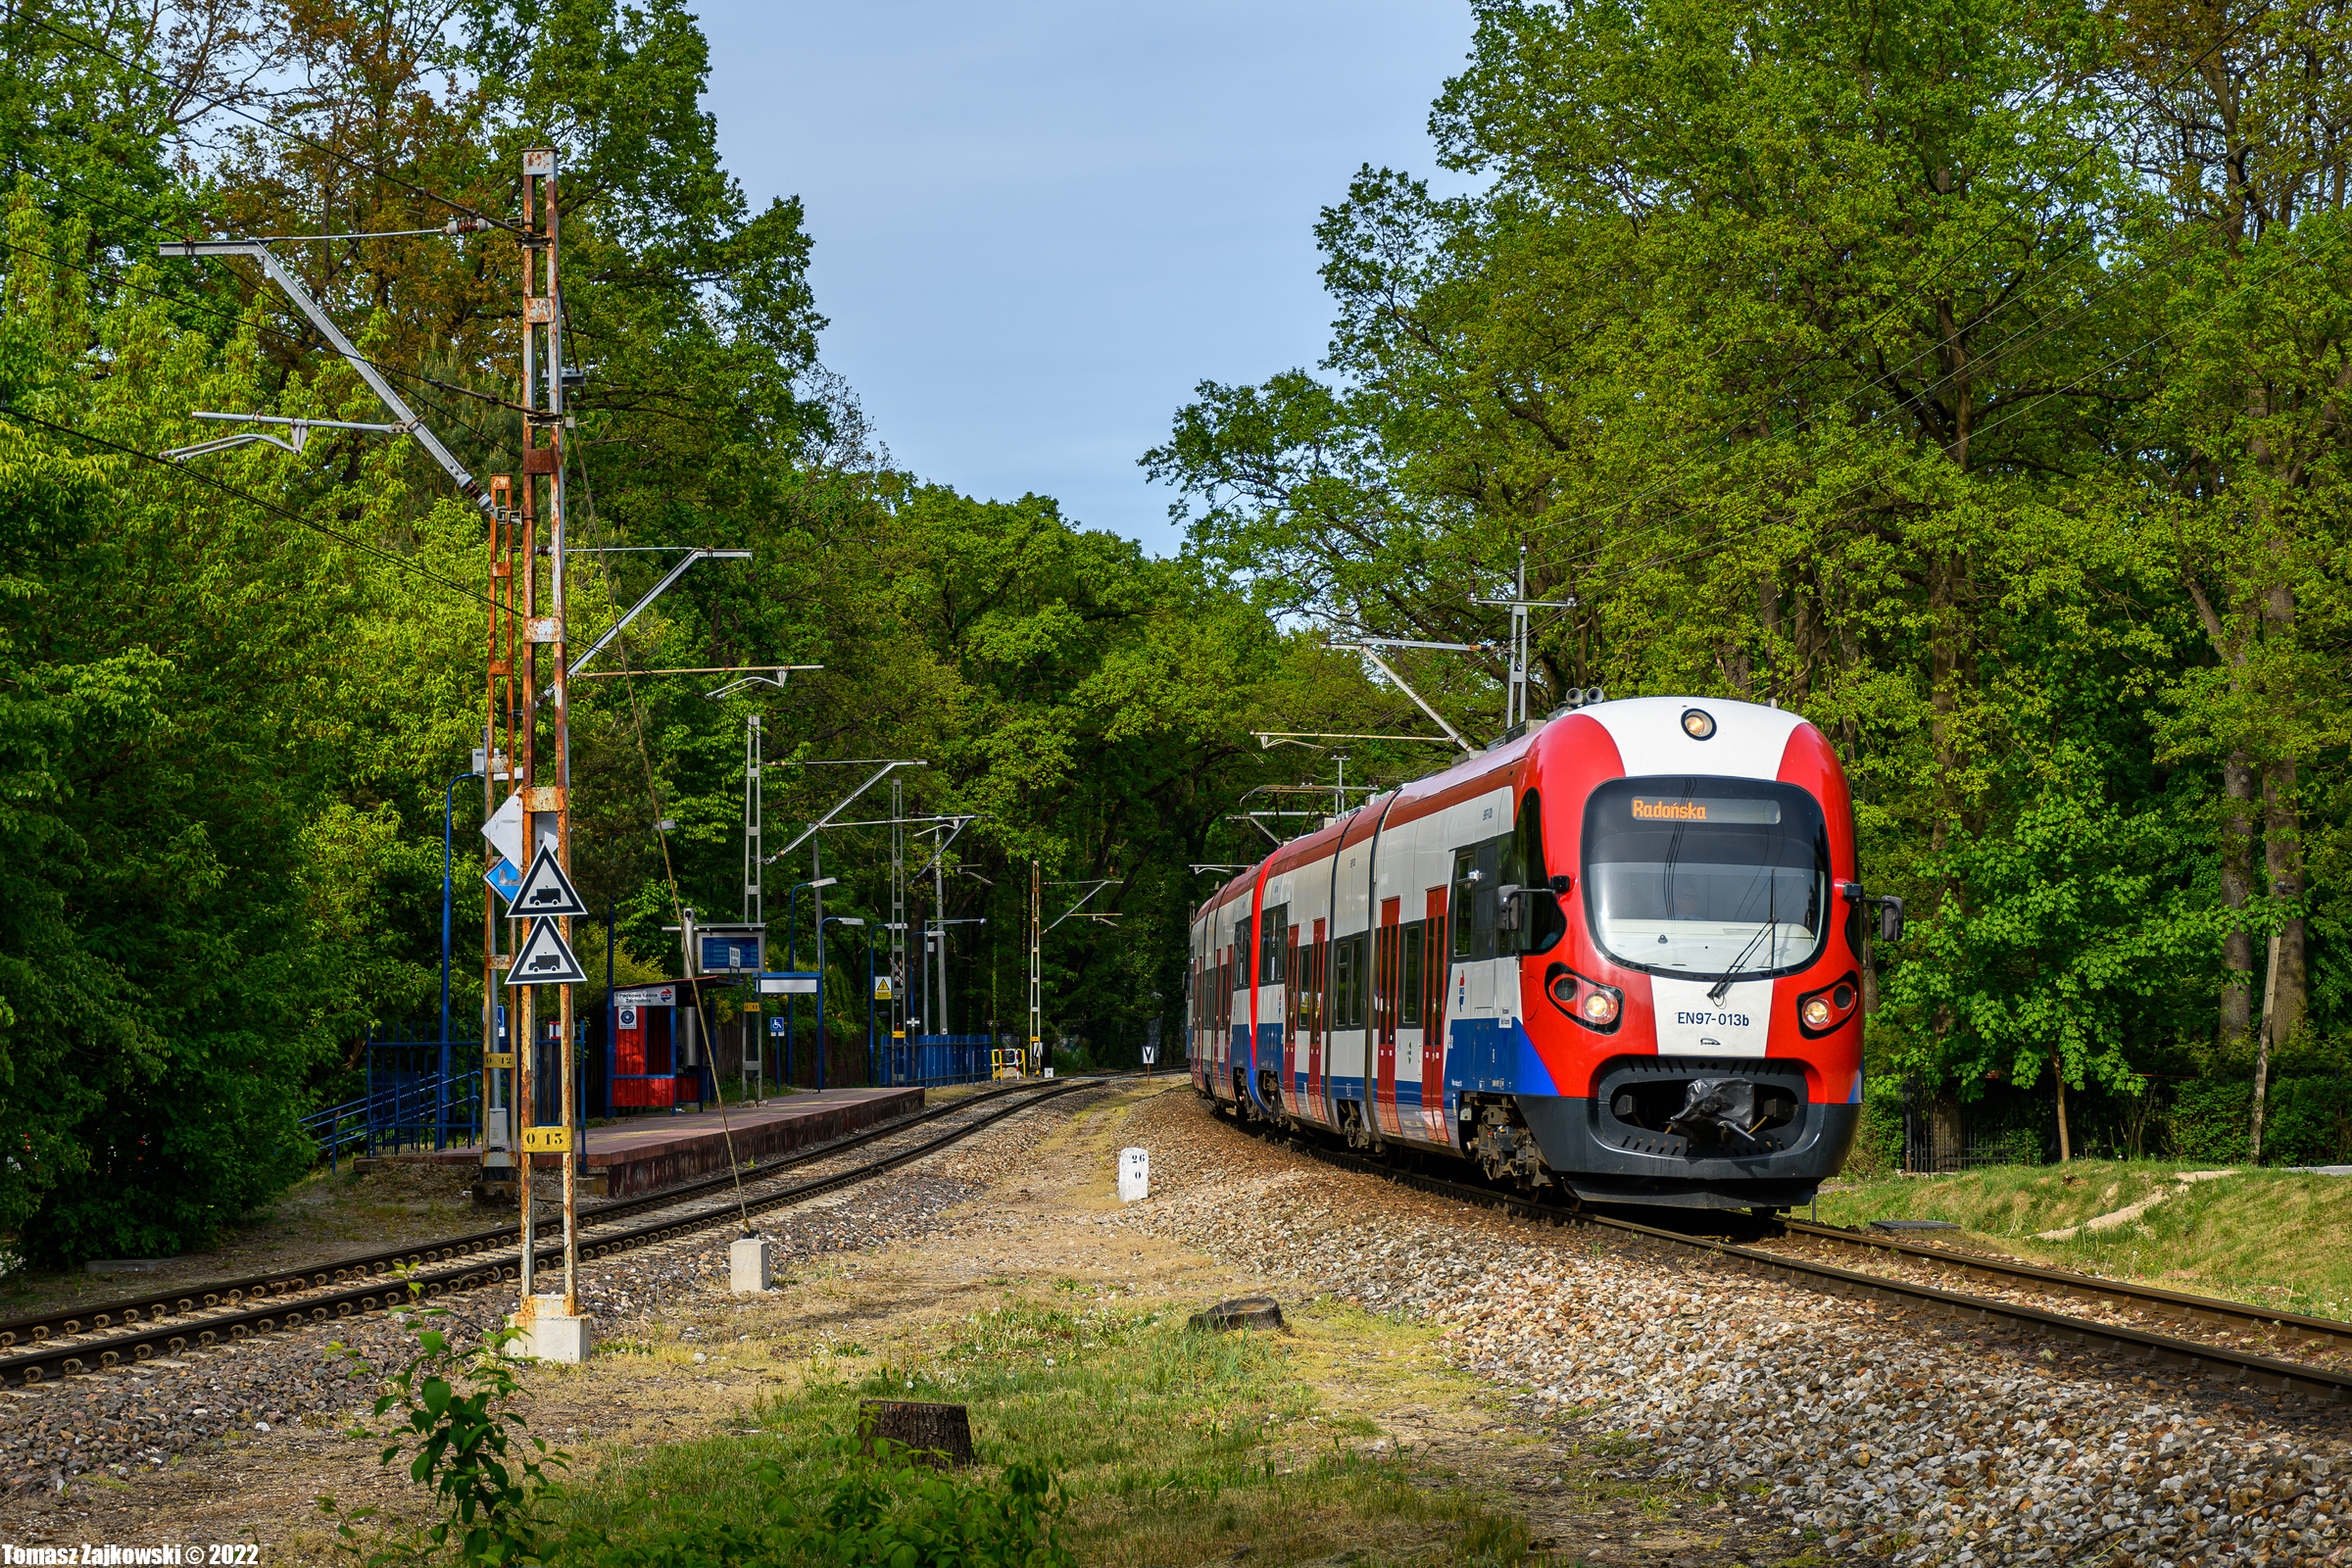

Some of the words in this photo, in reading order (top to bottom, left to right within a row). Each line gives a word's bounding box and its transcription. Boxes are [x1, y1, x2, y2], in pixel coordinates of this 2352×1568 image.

[1633, 800, 1706, 819] Radońska
[1678, 1011, 1749, 1027] EN97-013b
[1132, 1154, 1145, 1163] 26
